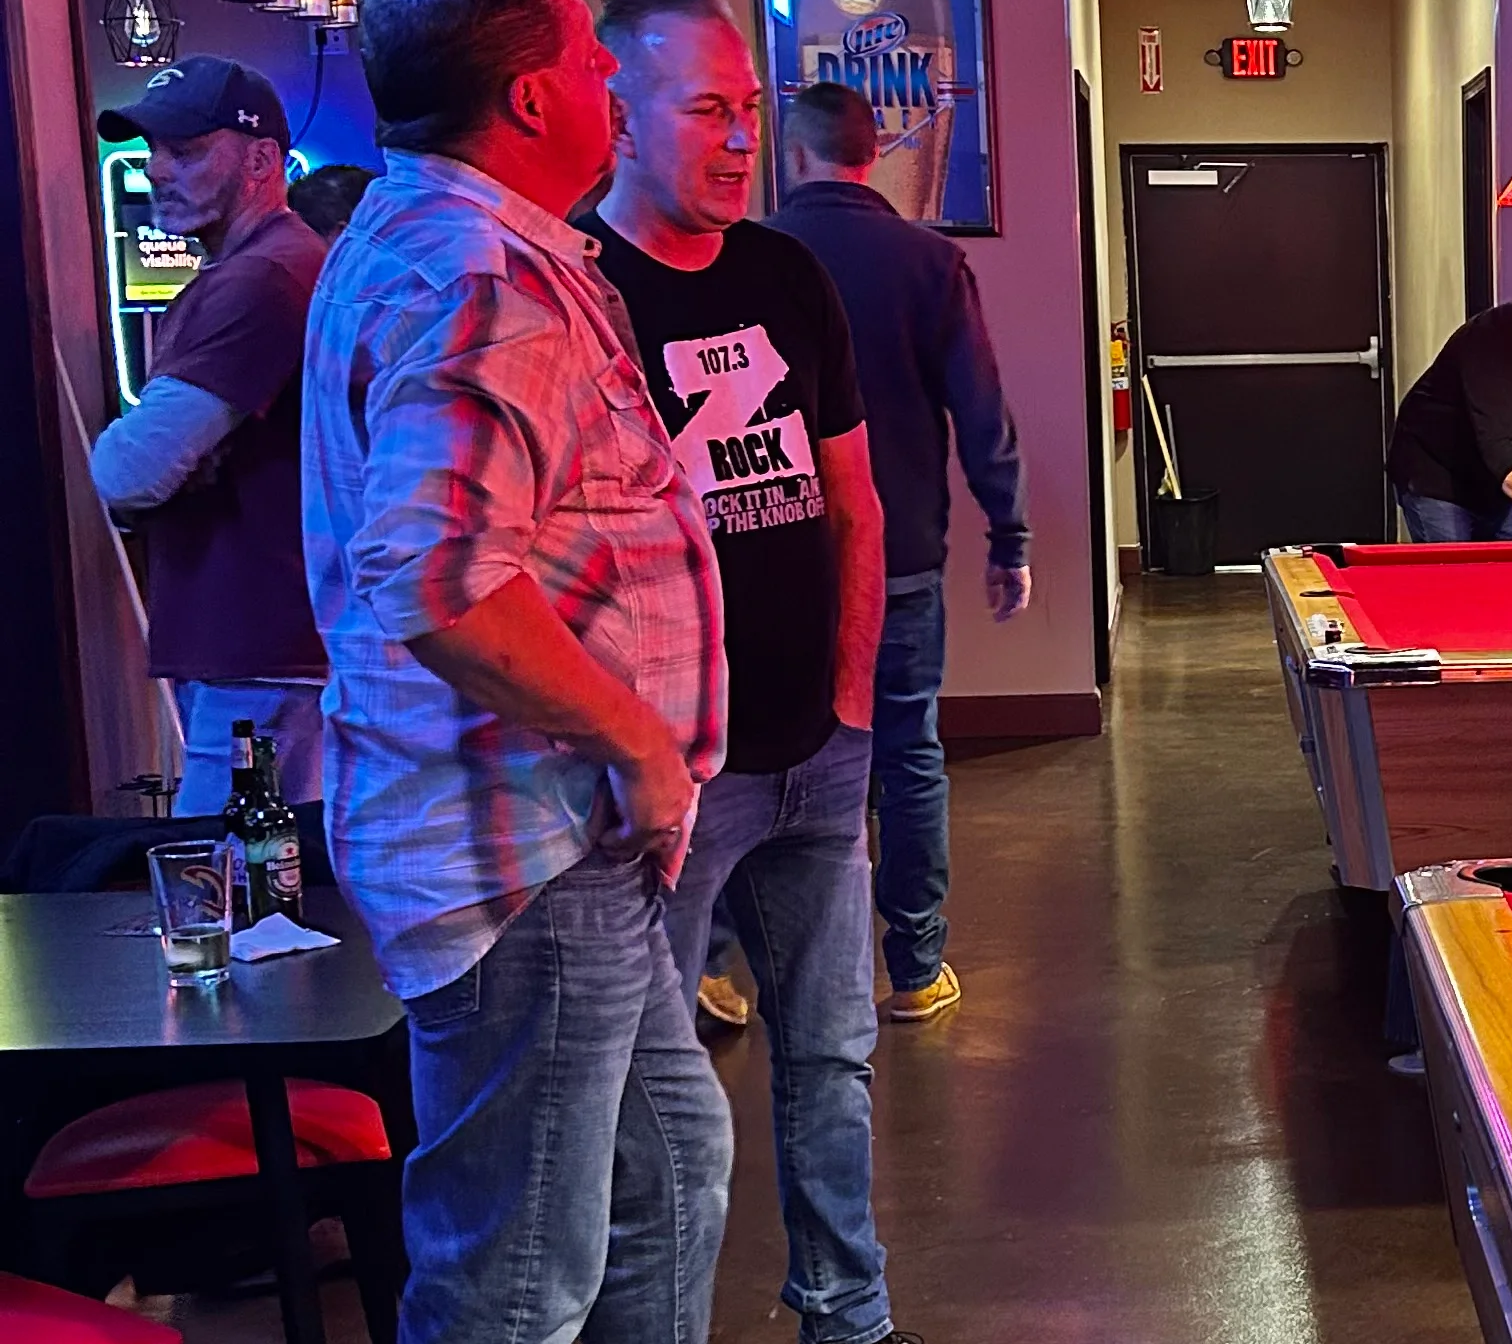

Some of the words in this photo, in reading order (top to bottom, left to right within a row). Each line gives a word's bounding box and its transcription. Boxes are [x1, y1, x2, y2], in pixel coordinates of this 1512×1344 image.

[852, 19, 903, 54] Lite
[1233, 39, 1278, 76] EXIT
[817, 52, 937, 107] DRINK
[138, 241, 187, 254] queue
[140, 253, 202, 270] visibility
[696, 342, 750, 375] 107.3
[706, 427, 793, 481] ROCK
[744, 489, 762, 510] IT
[724, 510, 759, 534] THE
[760, 501, 805, 528] KNOB
